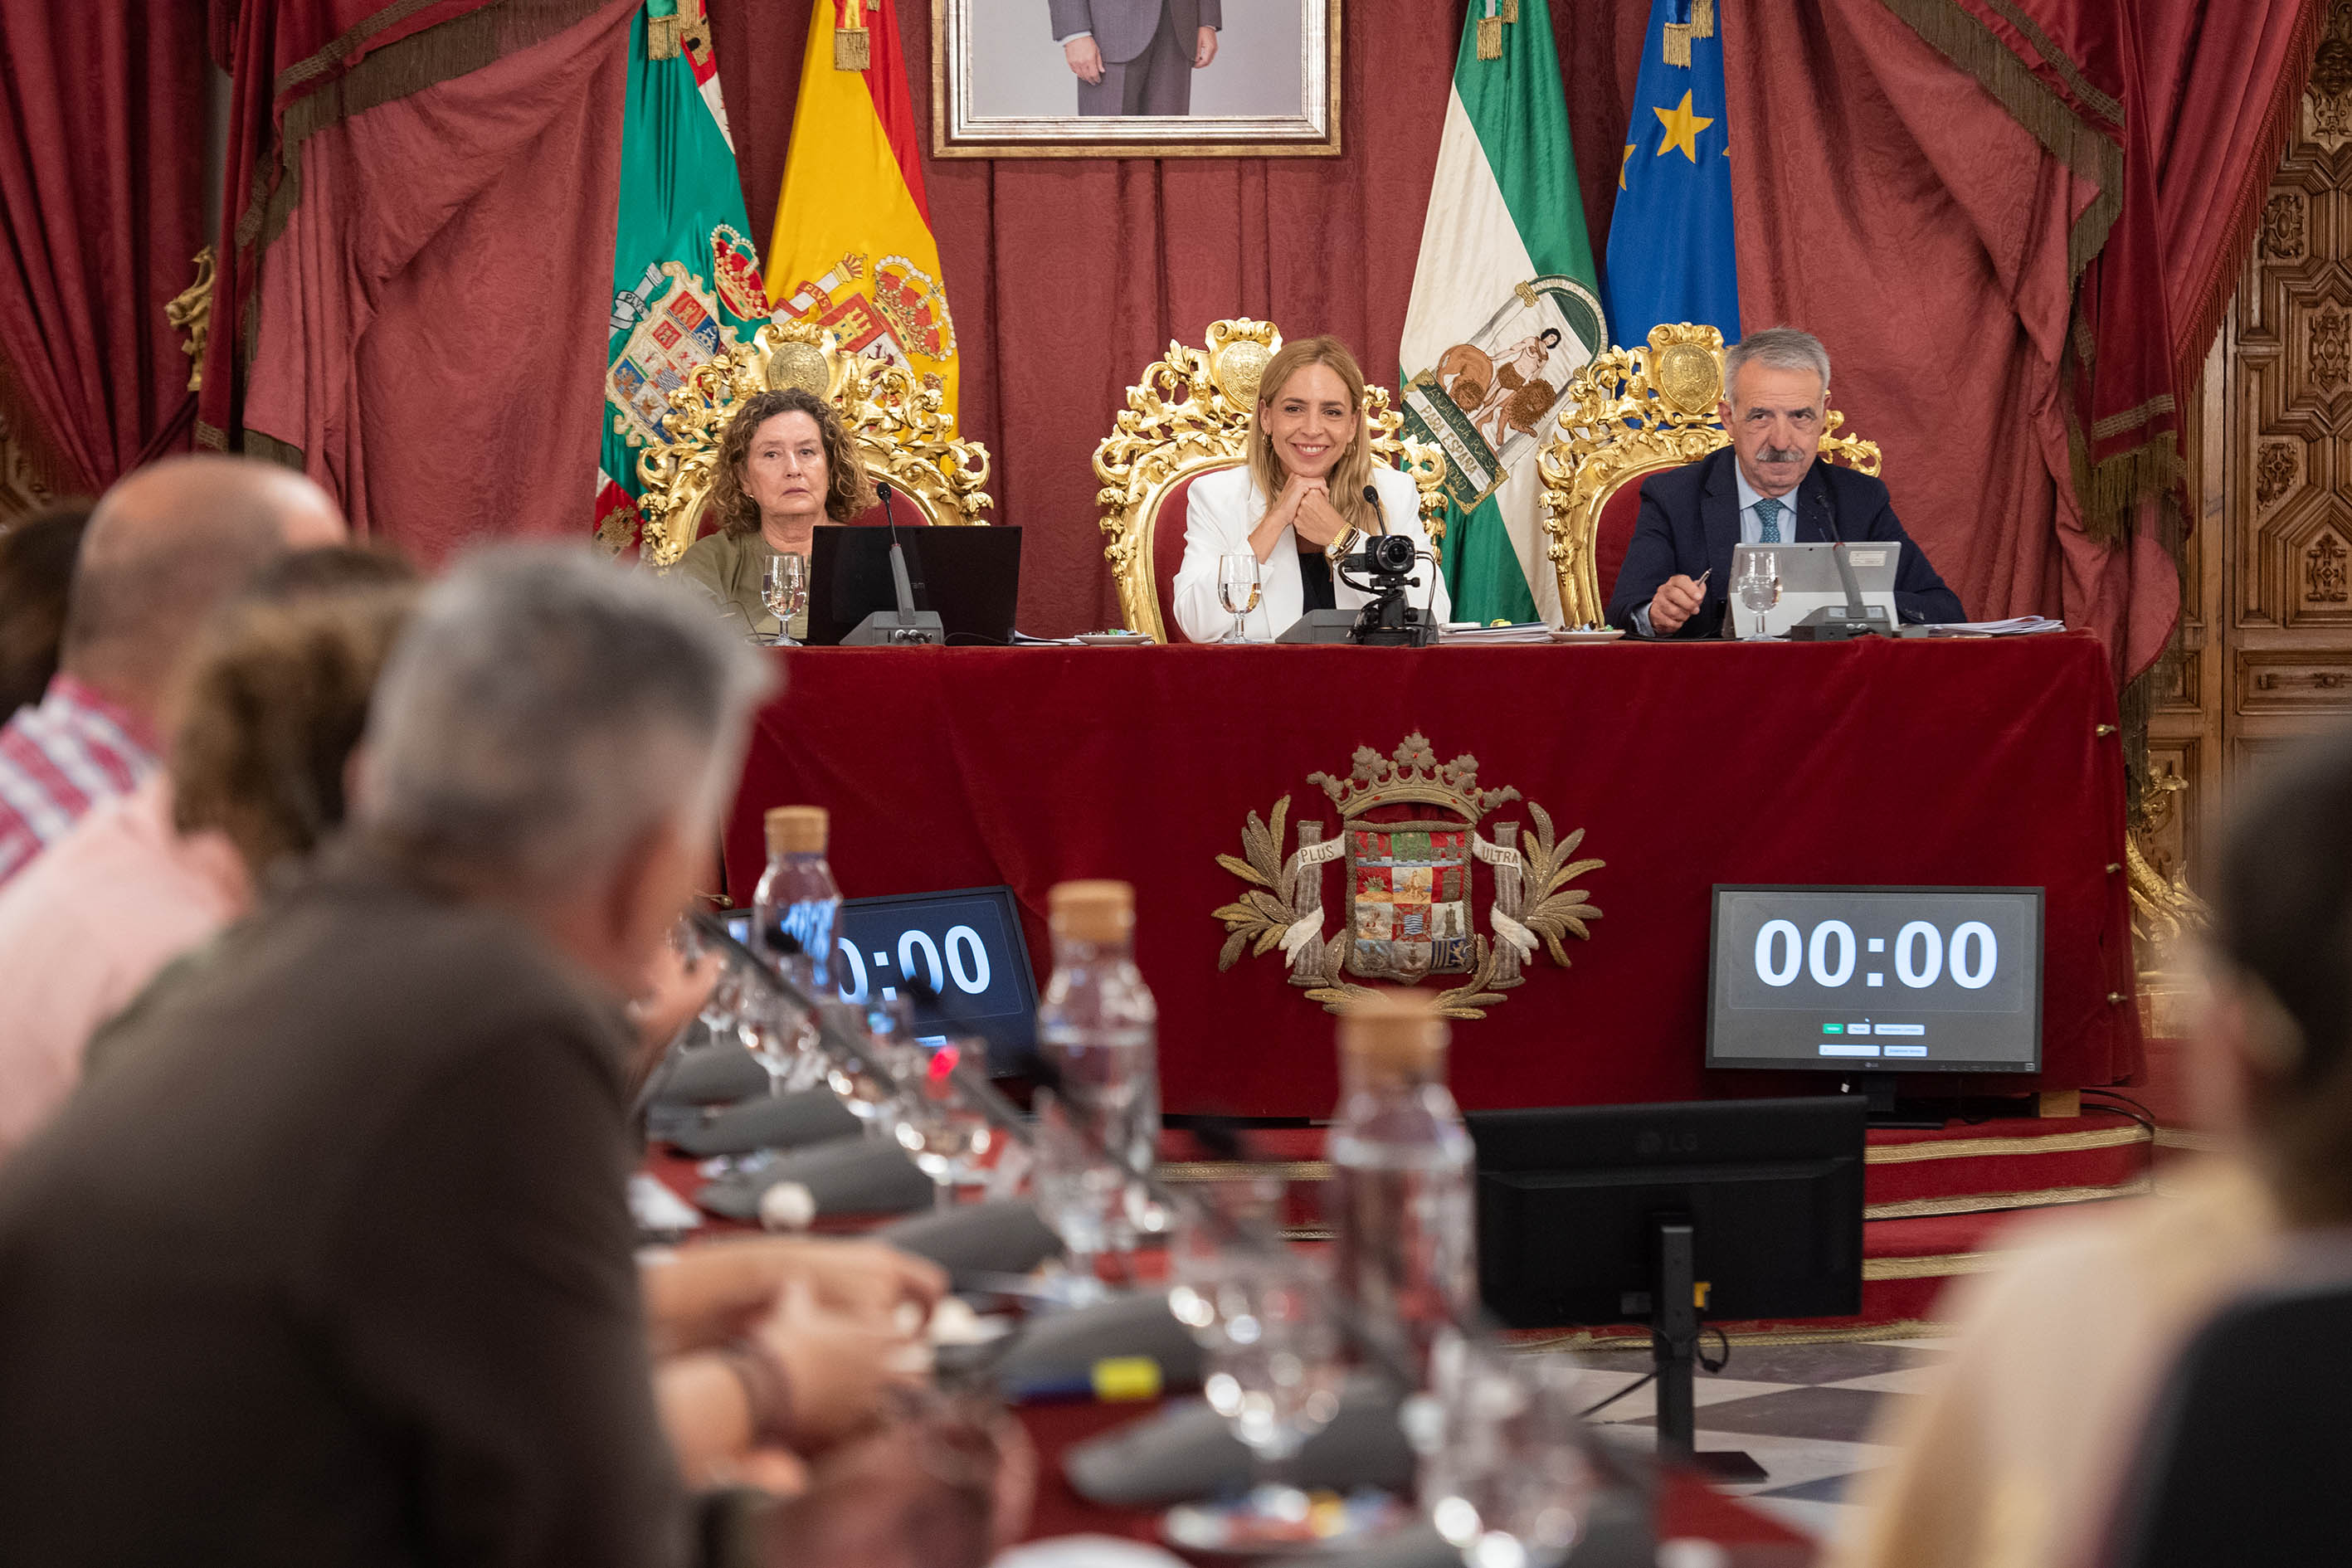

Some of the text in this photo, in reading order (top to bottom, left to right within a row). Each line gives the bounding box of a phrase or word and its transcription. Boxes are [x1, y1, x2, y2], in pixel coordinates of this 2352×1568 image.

[625, 293, 645, 314] PLVS
[804, 285, 830, 308] PLVS
[1406, 411, 1415, 421] Y
[1412, 423, 1427, 440] LA
[1419, 404, 1445, 436] PARA
[1470, 438, 1488, 462] POR
[1301, 845, 1519, 864] PLUS ULTRA
[839, 925, 991, 1005] 0:00
[1755, 919, 1998, 989] 00:00
